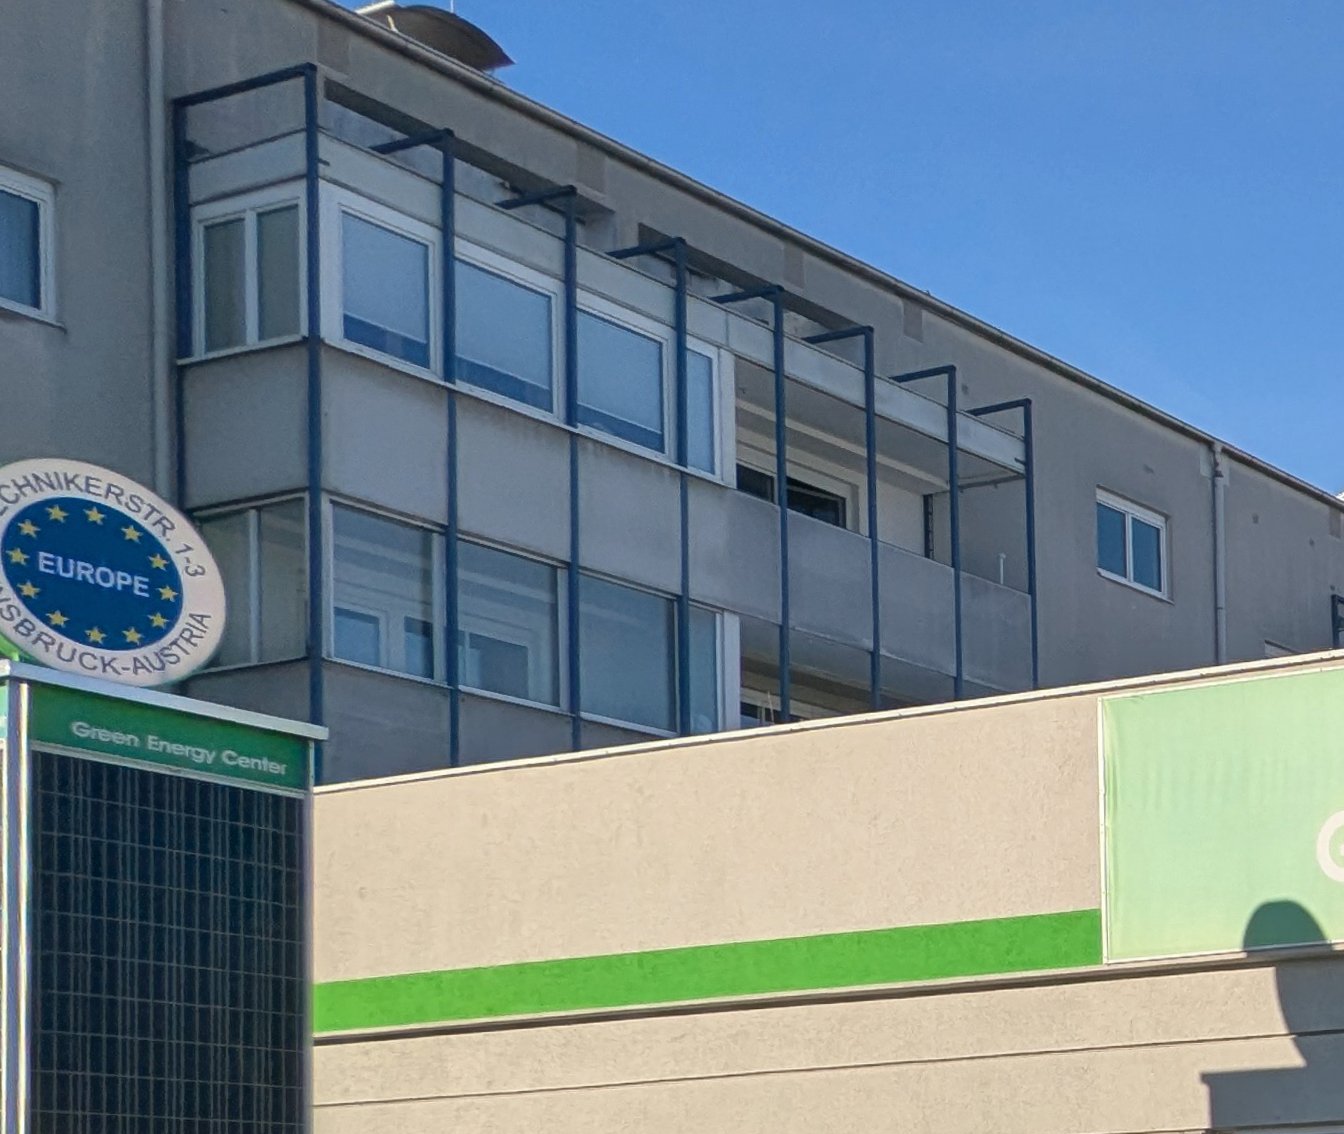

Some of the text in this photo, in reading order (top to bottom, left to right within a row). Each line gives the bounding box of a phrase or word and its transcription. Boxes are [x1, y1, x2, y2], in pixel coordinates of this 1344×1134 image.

[0, 471, 206, 578] CHNIKERSTR. 1-3
[38, 551, 150, 598] EUROPE
[71, 721, 287, 776] Green Energy Center
